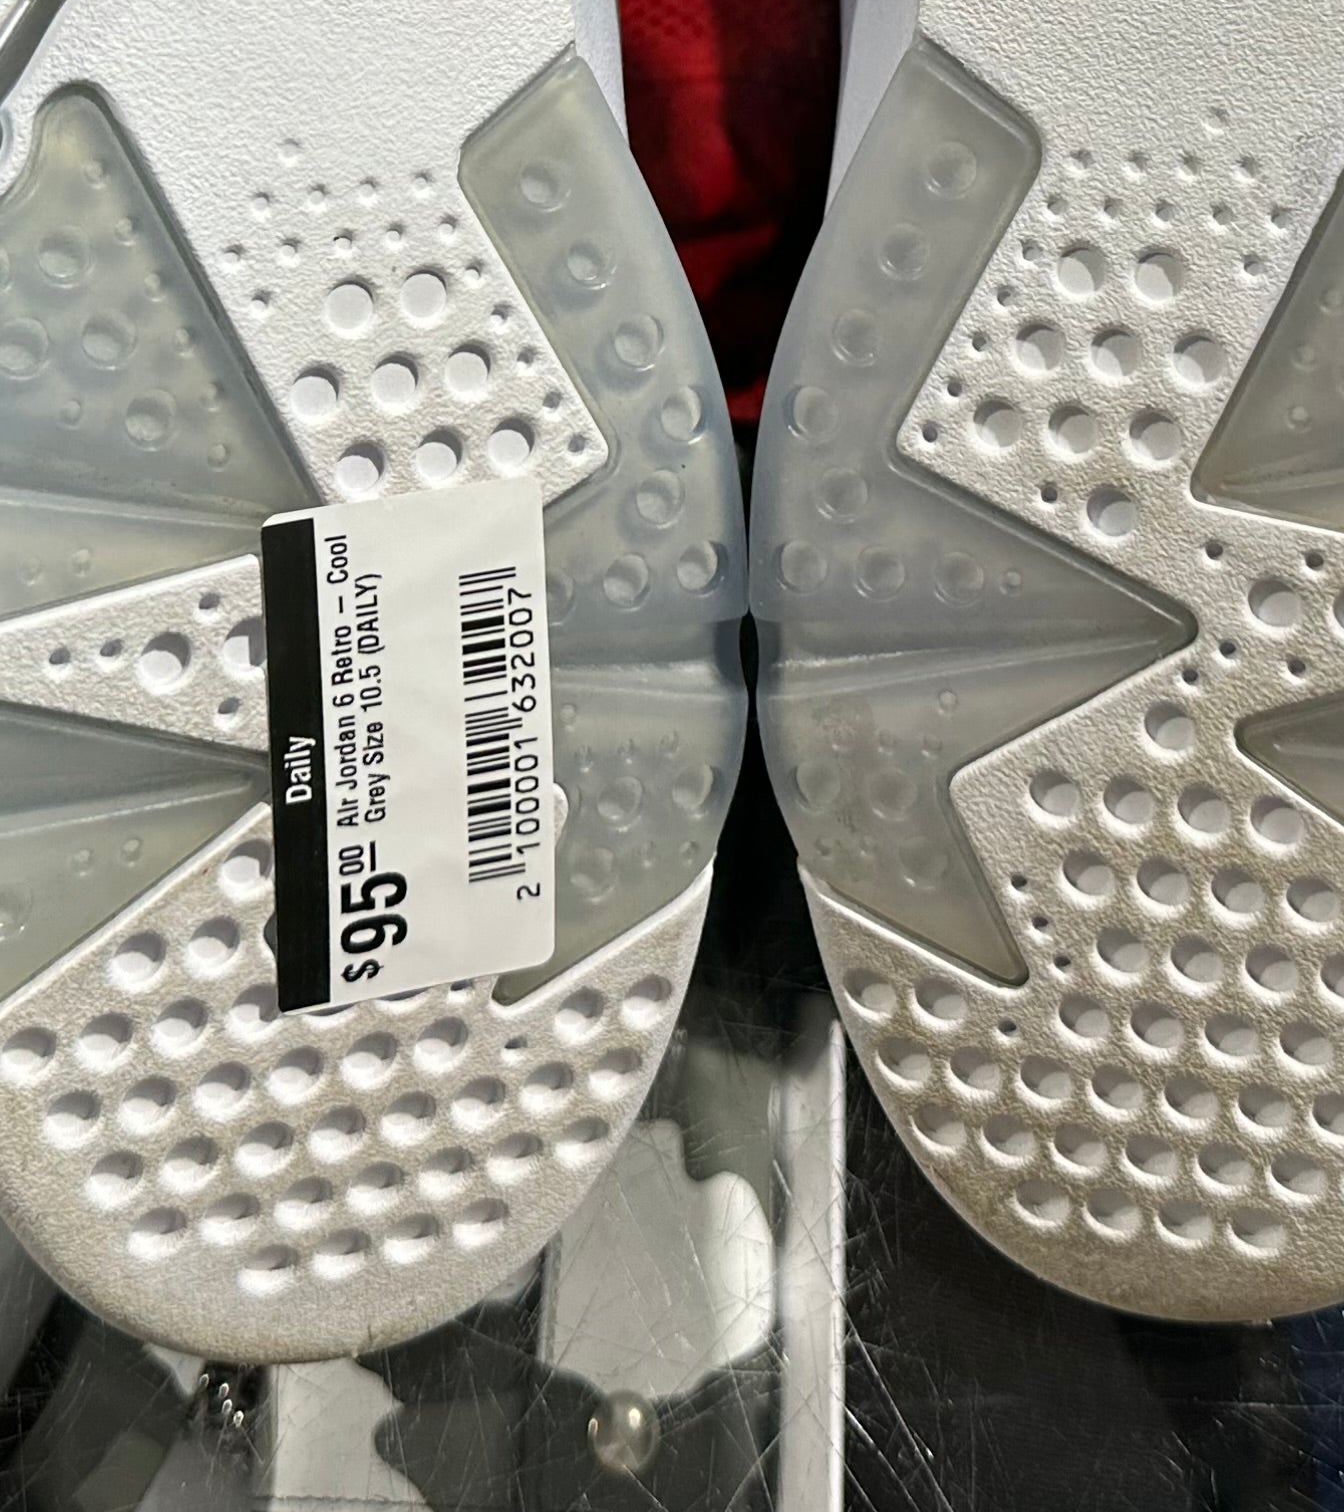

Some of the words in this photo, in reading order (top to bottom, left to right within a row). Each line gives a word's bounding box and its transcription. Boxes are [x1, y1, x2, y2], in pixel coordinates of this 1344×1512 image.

[324, 534, 350, 585] Cool
[354, 573, 385, 655] (DAILY)
[330, 625, 355, 686] Retro
[332, 693, 355, 708] 6
[358, 664, 383, 713] 10.5
[334, 714, 359, 790] Jordan
[361, 721, 385, 766] Size
[284, 735, 317, 805] Daily
[336, 798, 360, 827] Air
[363, 773, 391, 823] Grey
